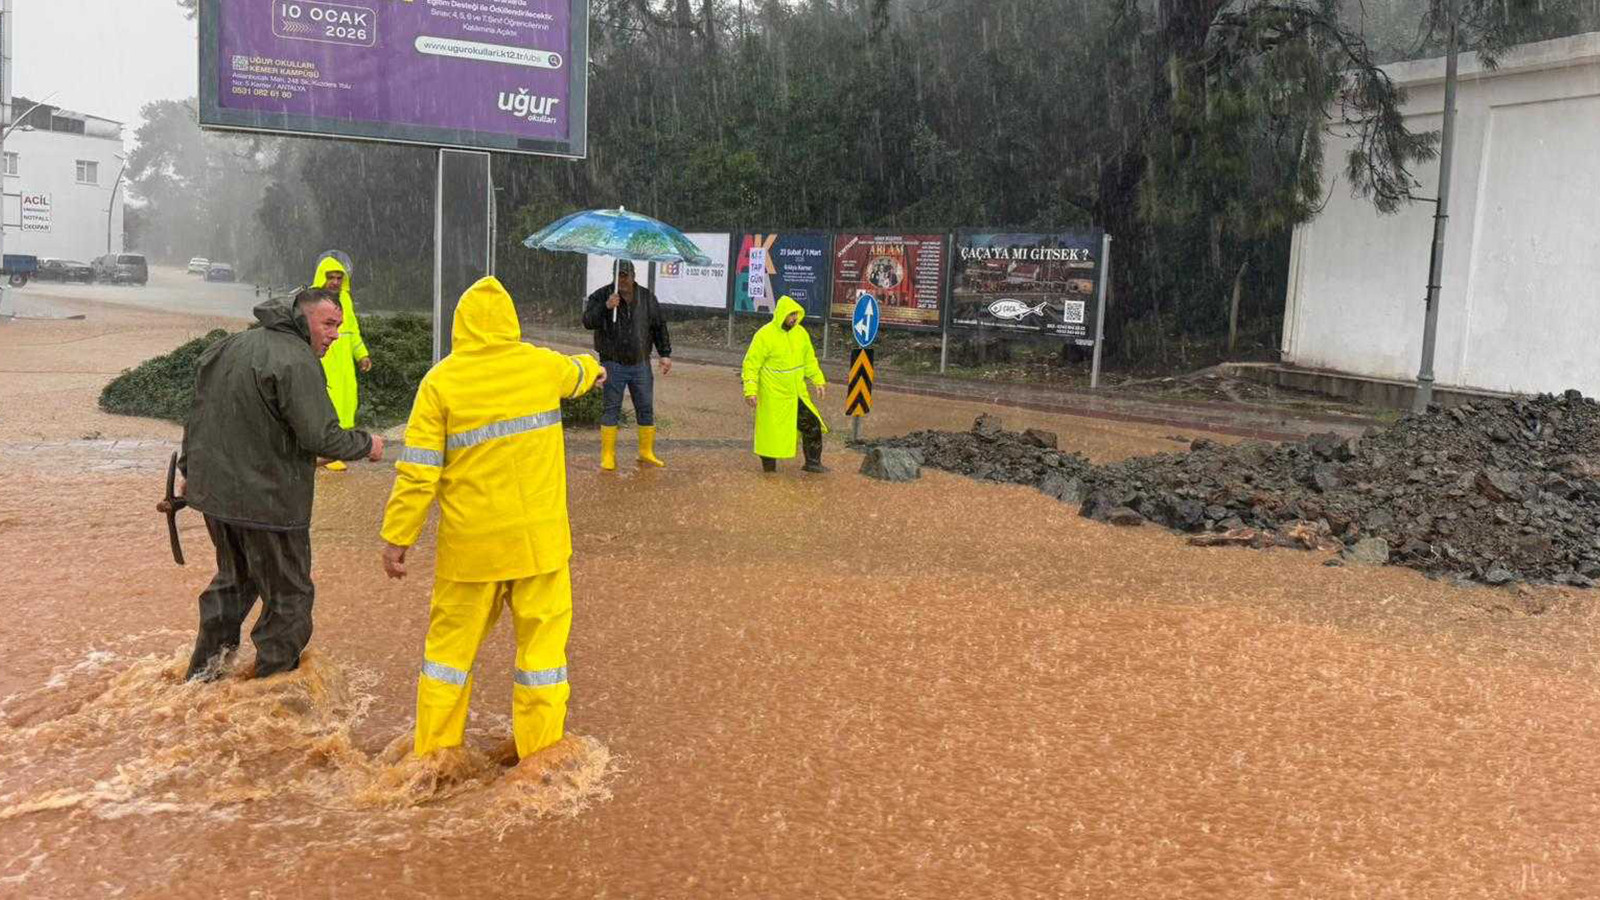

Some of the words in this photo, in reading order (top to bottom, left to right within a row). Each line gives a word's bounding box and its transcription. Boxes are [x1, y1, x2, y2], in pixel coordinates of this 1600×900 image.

[282, 3, 301, 18] 10
[310, 8, 367, 26] OCAK
[325, 26, 367, 40] 2026
[249, 56, 273, 65] UĞUR
[274, 59, 315, 69] OKULLARI
[250, 66, 278, 74] KEMER
[280, 68, 320, 78] KAMPÜSÜ
[498, 87, 559, 117] uğur
[24, 195, 50, 205] ACİL
[961, 247, 1009, 260] ÇAÇA'YA
[1012, 248, 1027, 259] MI
[1030, 245, 1080, 260] GİTSEK
[1083, 250, 1089, 260] ?
